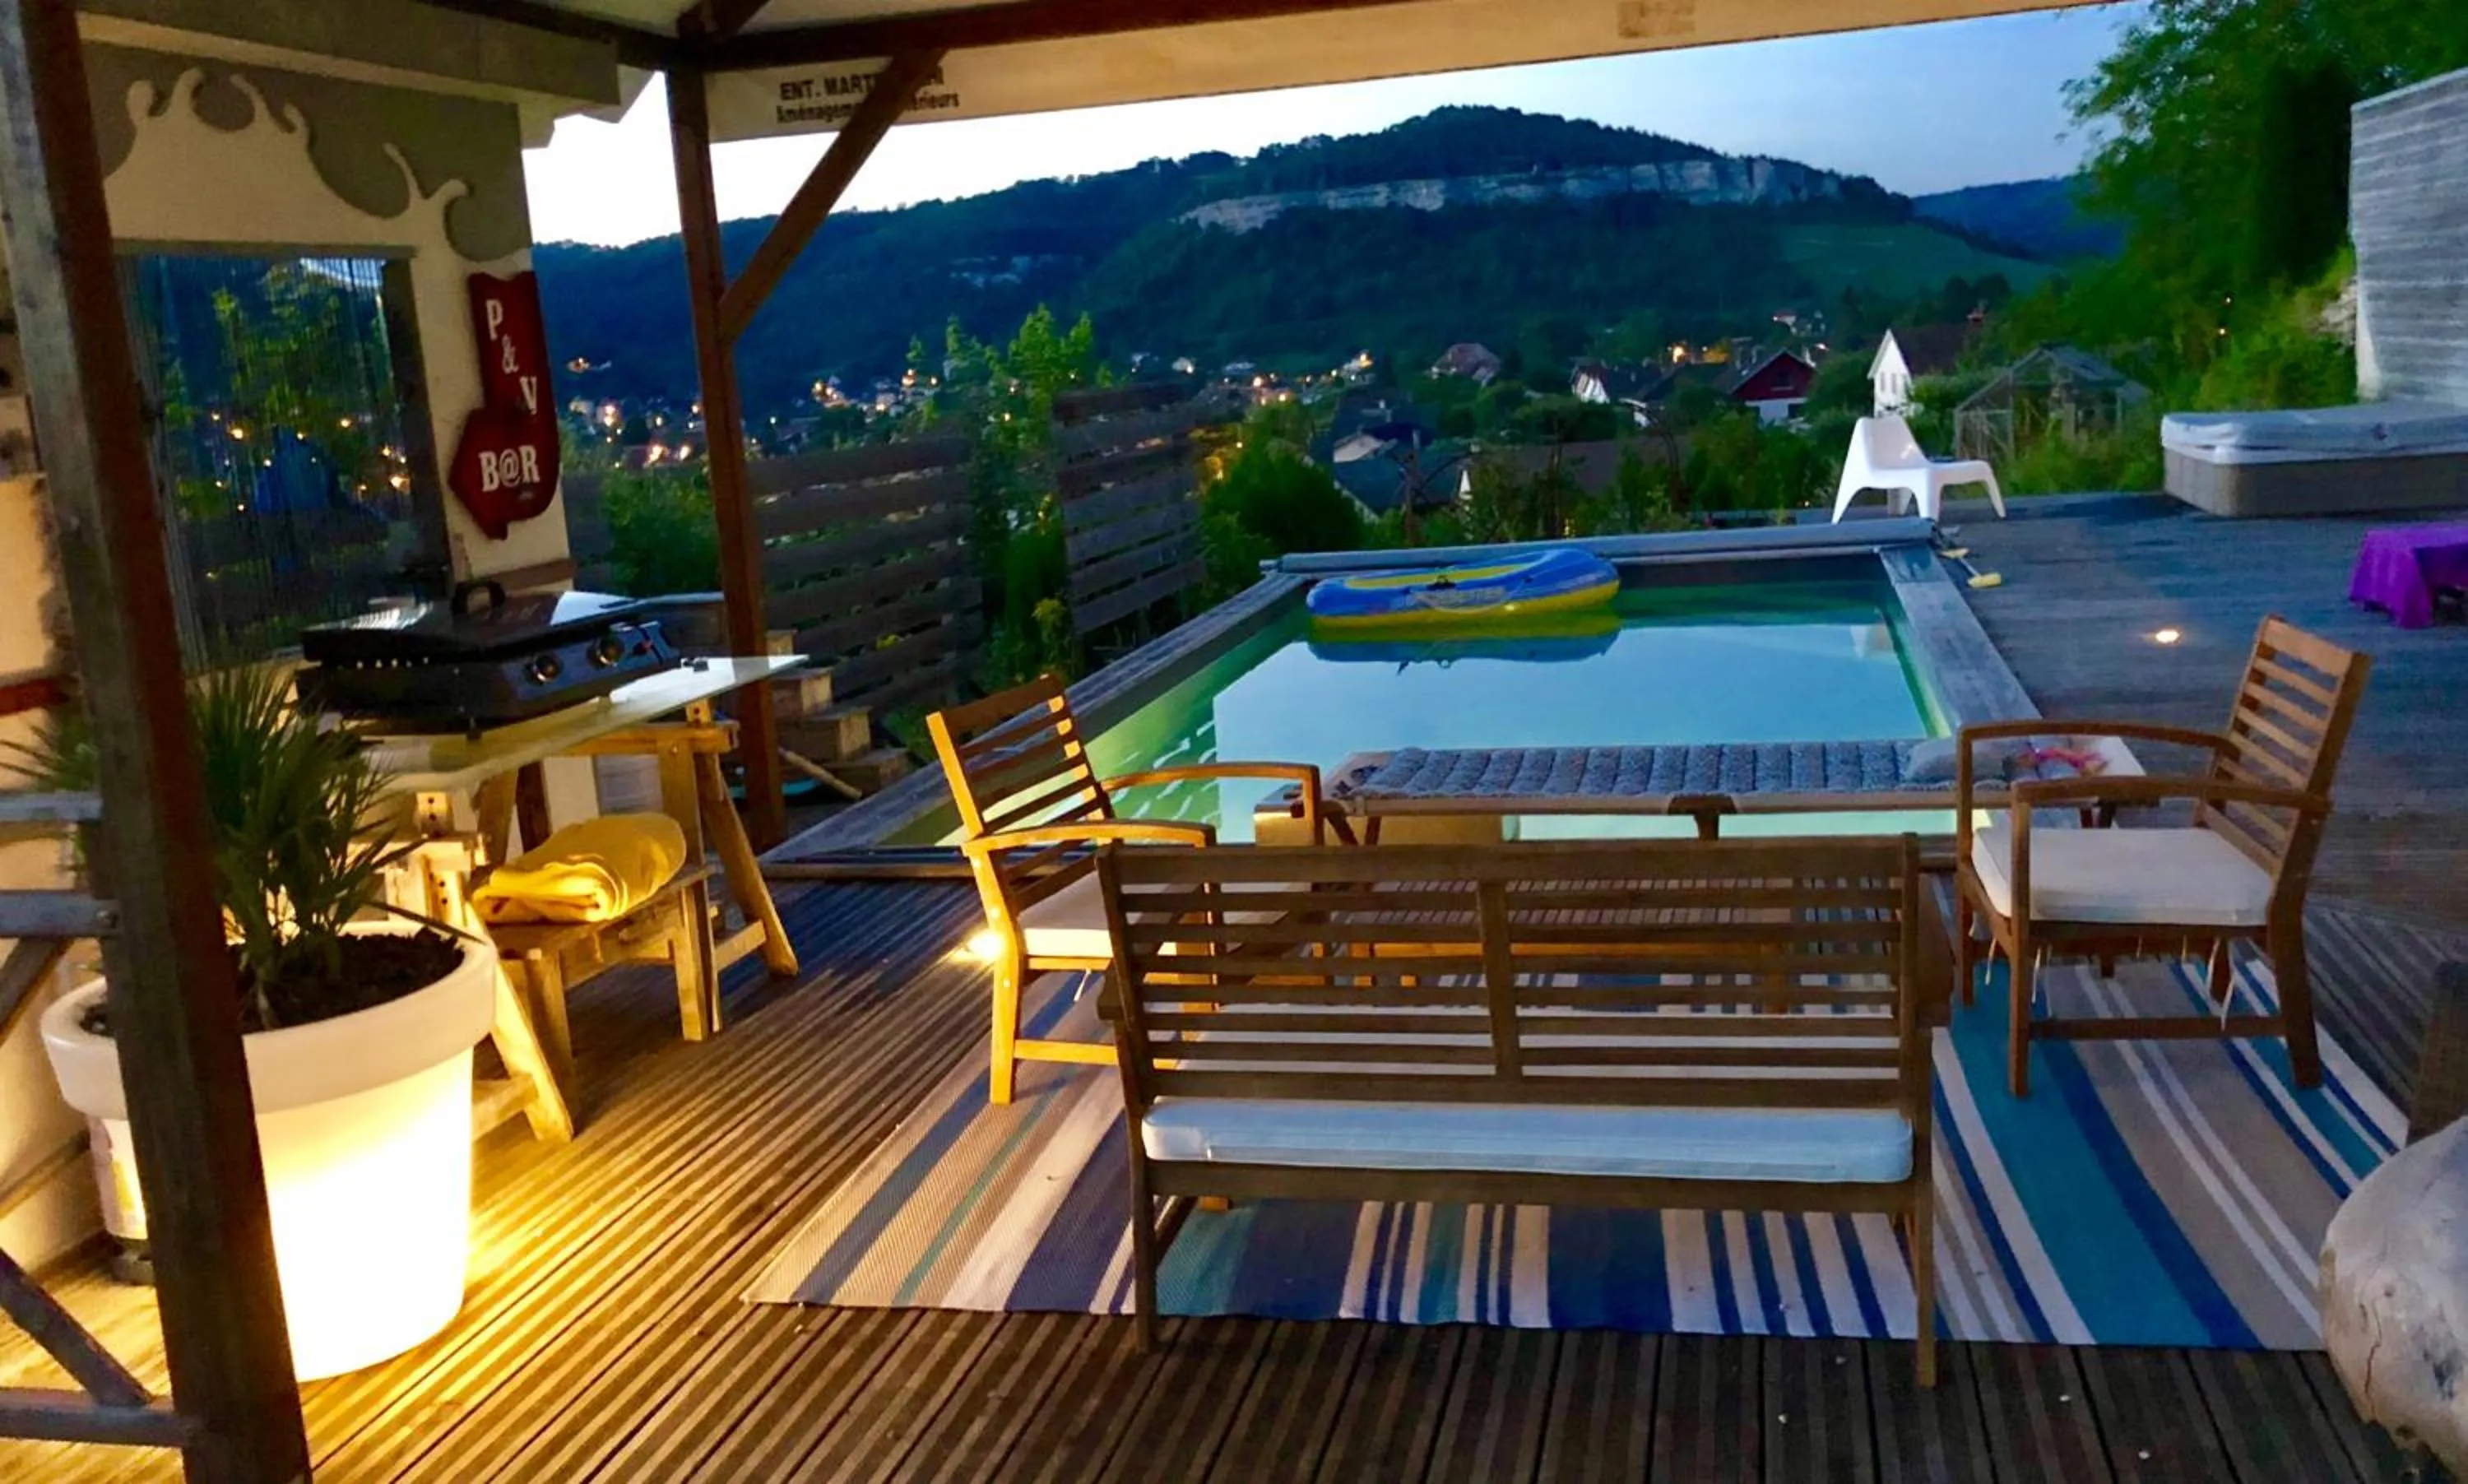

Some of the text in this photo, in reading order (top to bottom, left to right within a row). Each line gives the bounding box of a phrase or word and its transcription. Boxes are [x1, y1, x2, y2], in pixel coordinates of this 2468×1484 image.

[779, 79, 821, 100] ENT.
[485, 299, 537, 415] P & V
[478, 444, 540, 493] B@R
